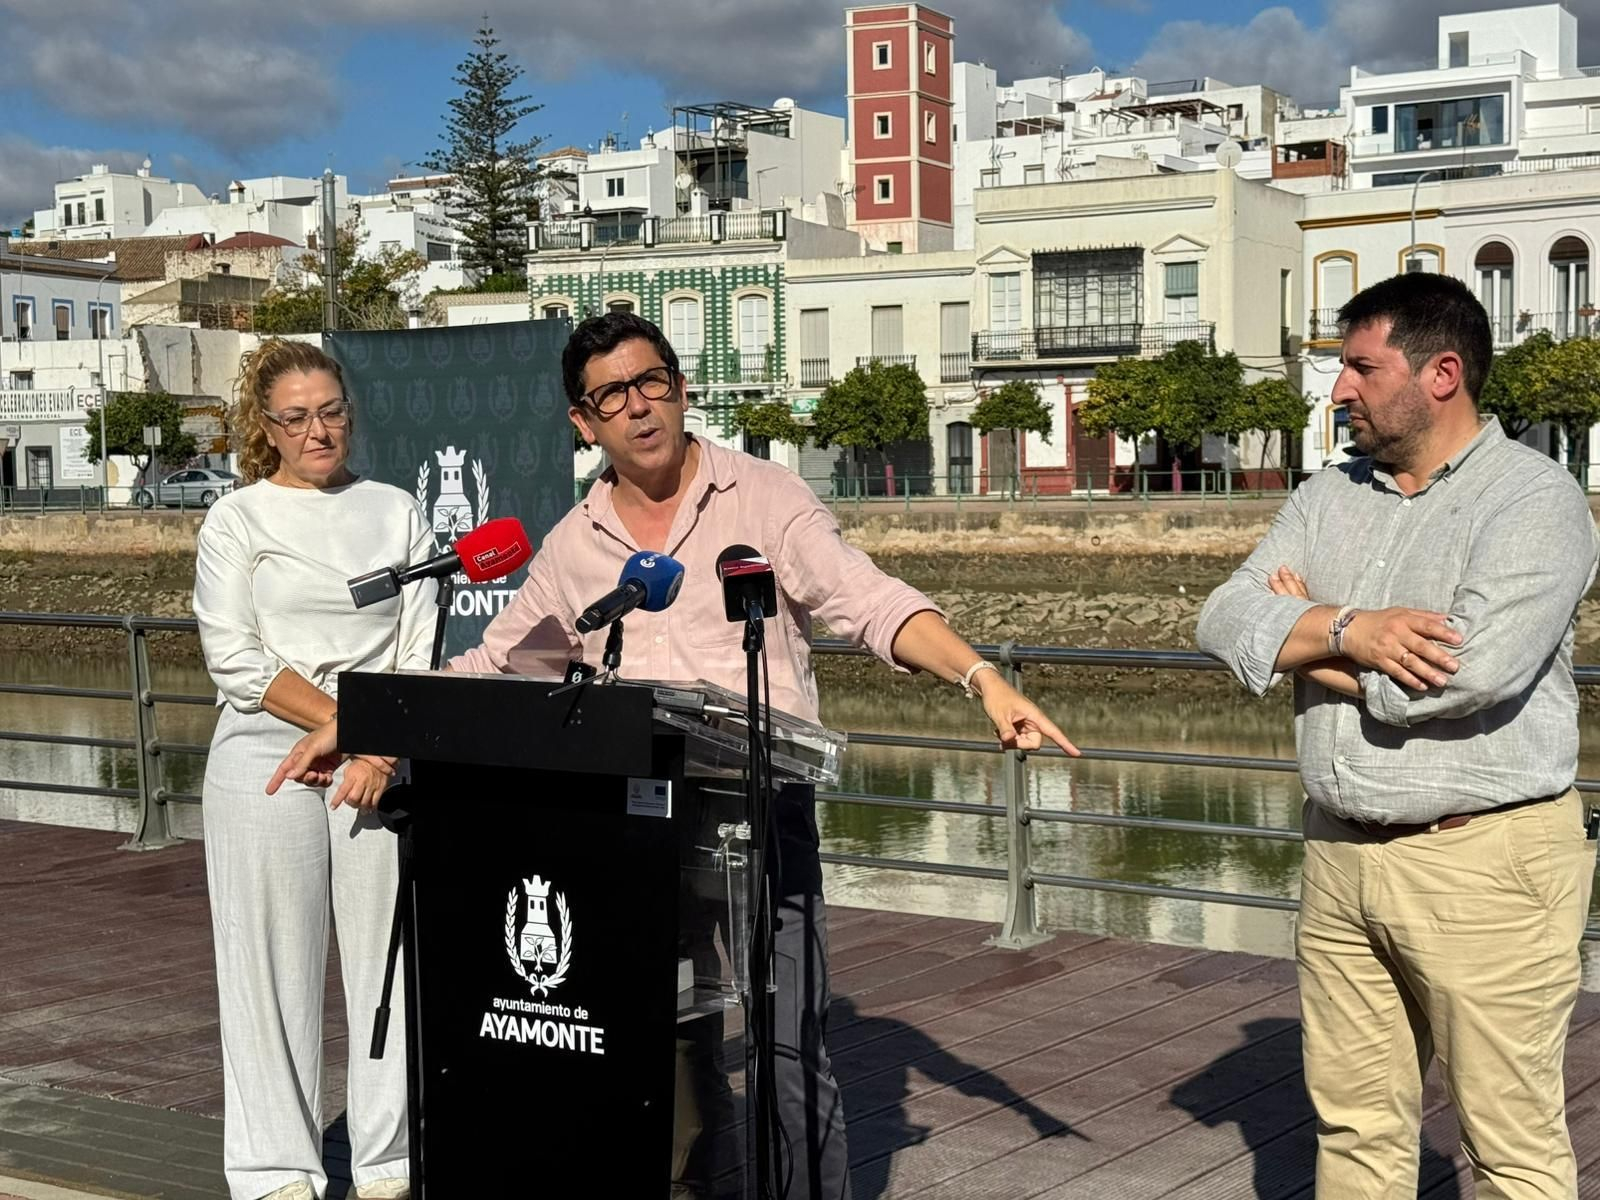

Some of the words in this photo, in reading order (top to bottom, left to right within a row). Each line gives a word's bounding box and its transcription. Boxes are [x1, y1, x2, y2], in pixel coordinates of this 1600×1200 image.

[77, 394, 101, 407] ECE
[476, 550, 496, 562] Canal
[492, 997, 571, 1018] ayuntamiento
[573, 1006, 589, 1020] de
[479, 1012, 605, 1055] AYAMONTE
